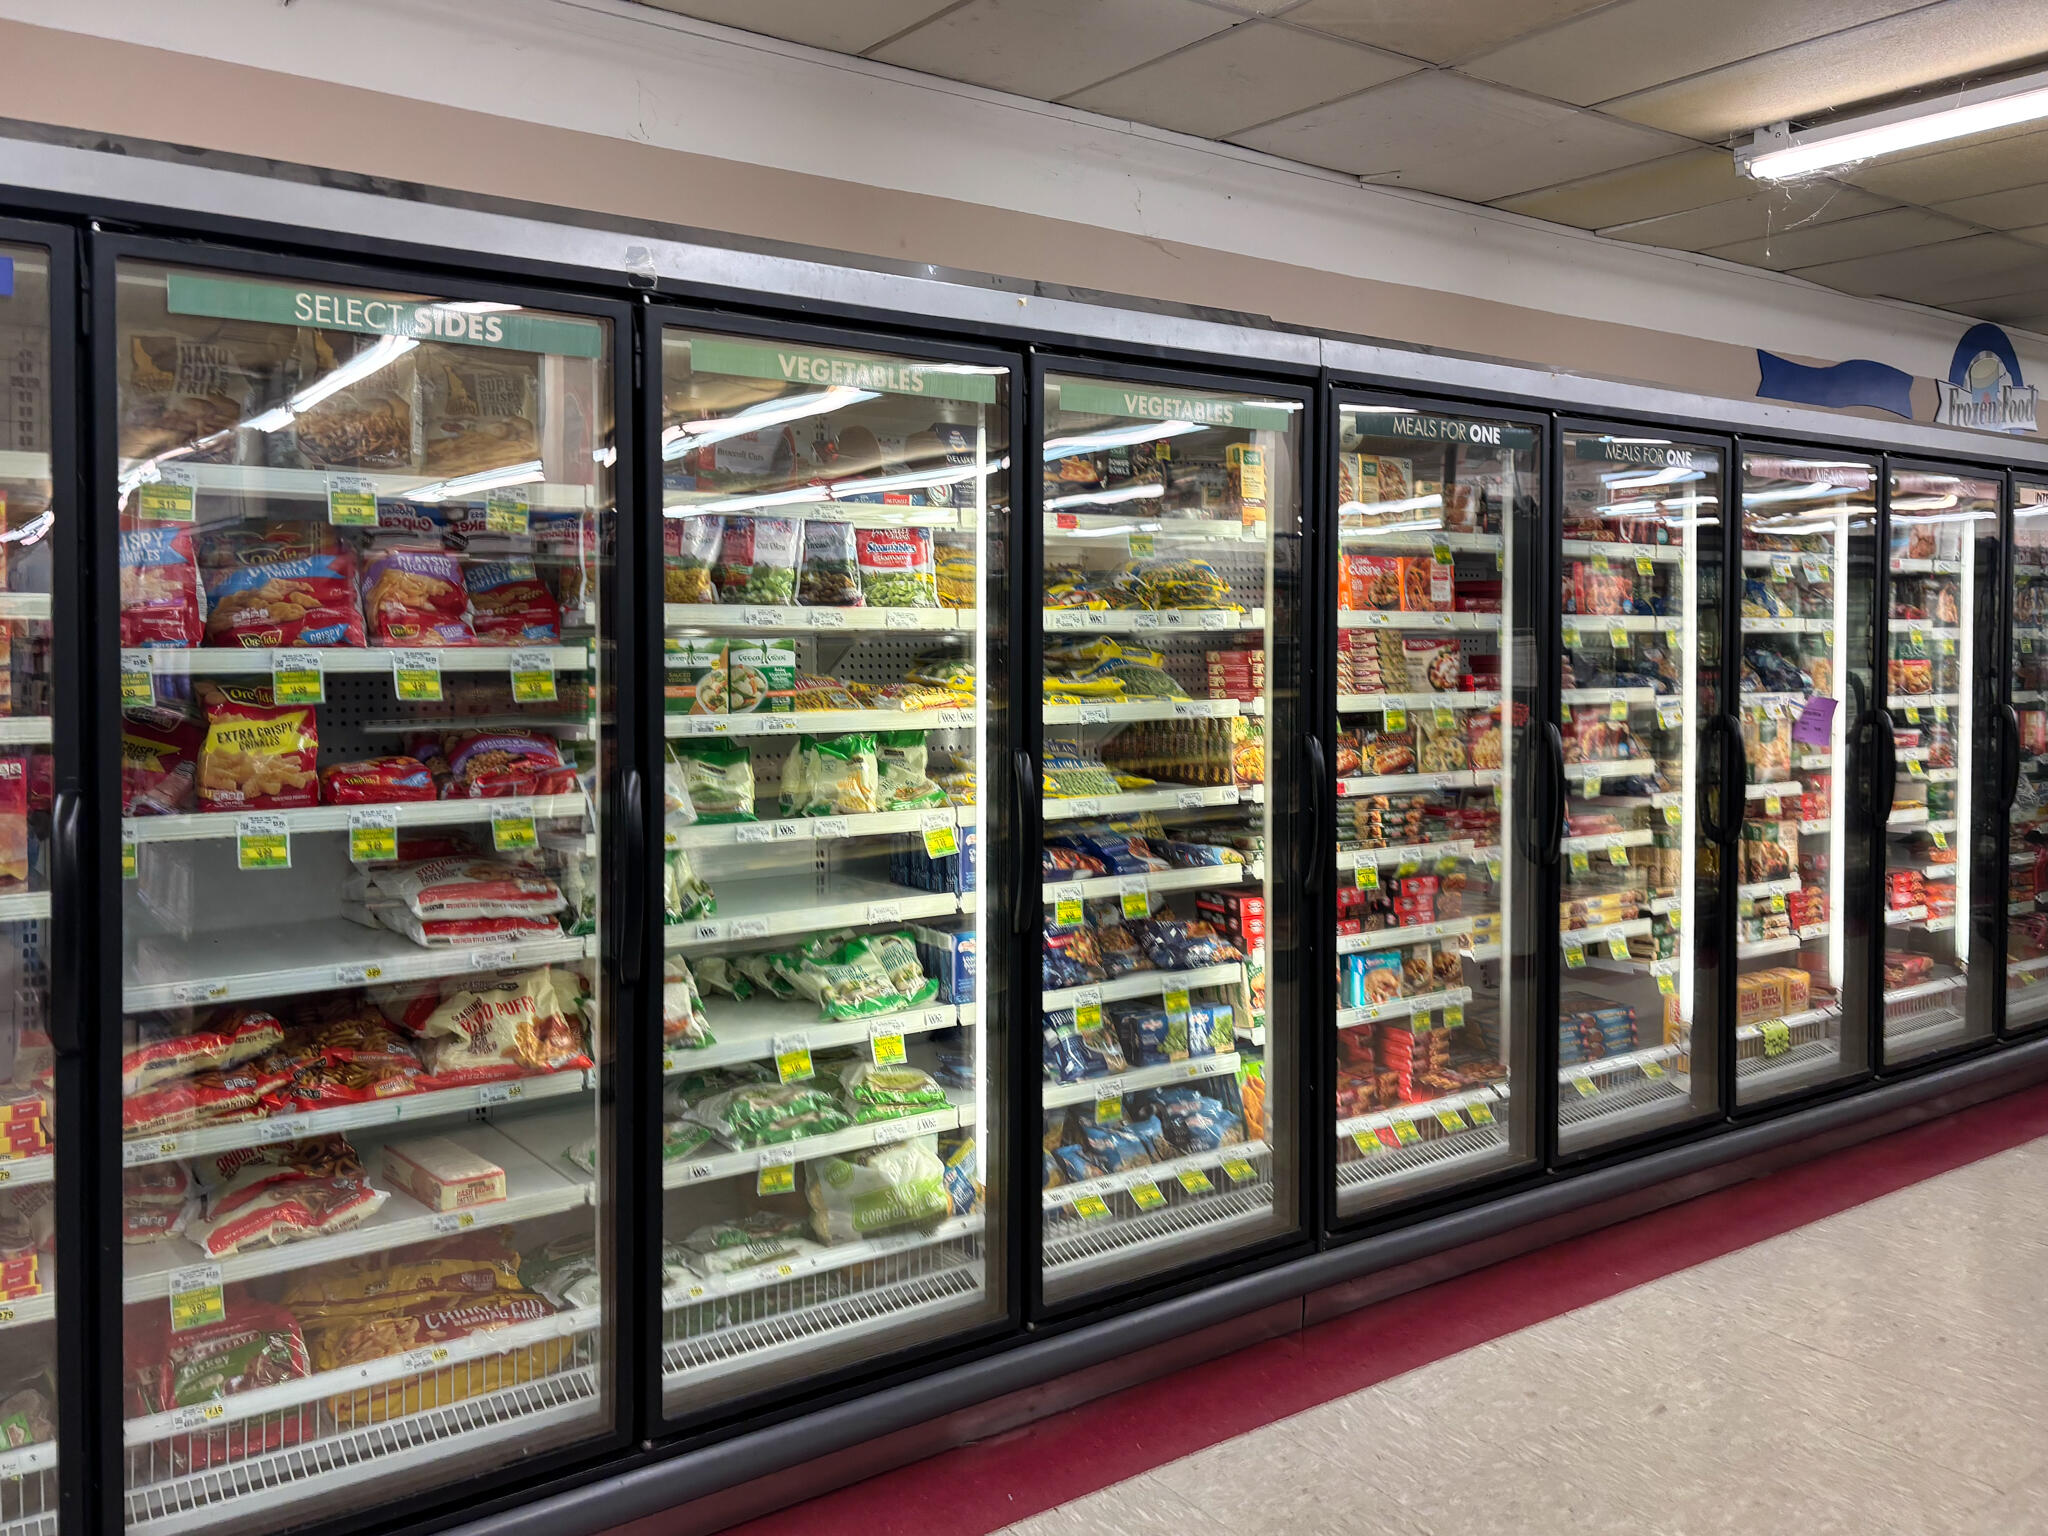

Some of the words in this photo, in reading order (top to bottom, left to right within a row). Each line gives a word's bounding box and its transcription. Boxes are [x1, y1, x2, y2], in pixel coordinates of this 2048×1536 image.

[294, 292, 403, 328] SELECT
[414, 307, 503, 342] SIDES
[778, 353, 925, 393] VEGETABLES
[1123, 393, 1234, 424] VEGETABLES
[1949, 387, 1999, 427] Frozen
[2000, 384, 2036, 424] Food
[1392, 416, 1437, 439] MEALS
[1439, 421, 1466, 441] FOR
[1469, 424, 1501, 445] ONE
[945, 453, 975, 466] DELUX
[1604, 443, 1641, 463] MEALS
[1643, 447, 1664, 464] FOR
[1666, 449, 1693, 468] ONE
[120, 531, 164, 554] ISPY
[120, 553, 161, 562] INKLES
[216, 728, 254, 744] EXTRA
[257, 721, 292, 738] CRISPY
[496, 995, 536, 1017] PUFFS
[216, 1146, 256, 1173] ONION
[861, 1208, 891, 1224] CORN
[180, 1354, 230, 1381] Turkey
